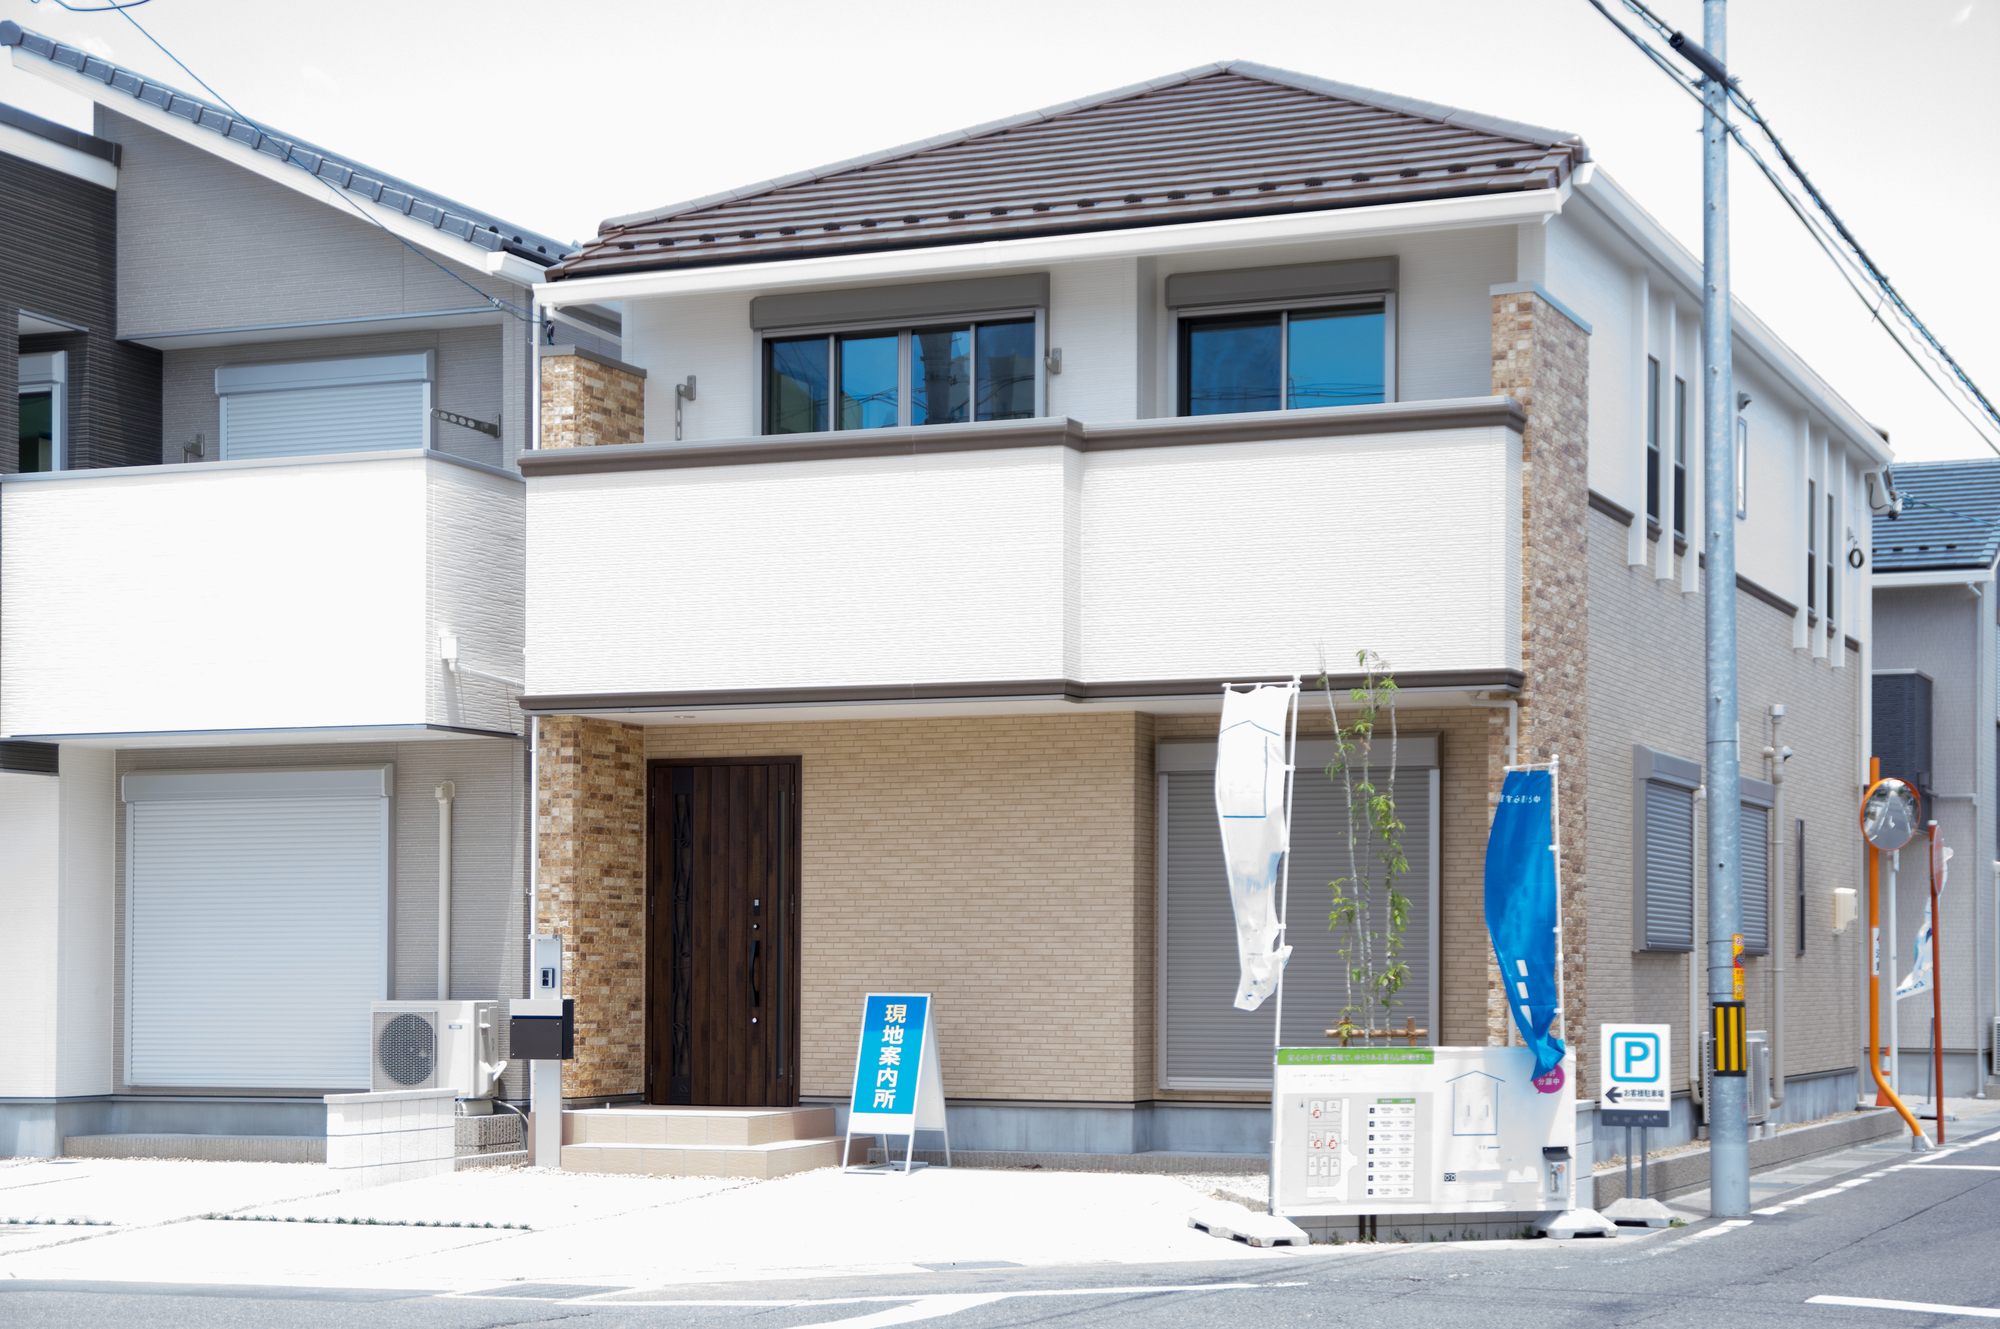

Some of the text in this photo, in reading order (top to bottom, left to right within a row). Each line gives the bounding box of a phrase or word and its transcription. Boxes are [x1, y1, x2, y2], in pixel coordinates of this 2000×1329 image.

[872, 1004, 907, 1109] 現地案内所
[1625, 1041, 1650, 1073] P
